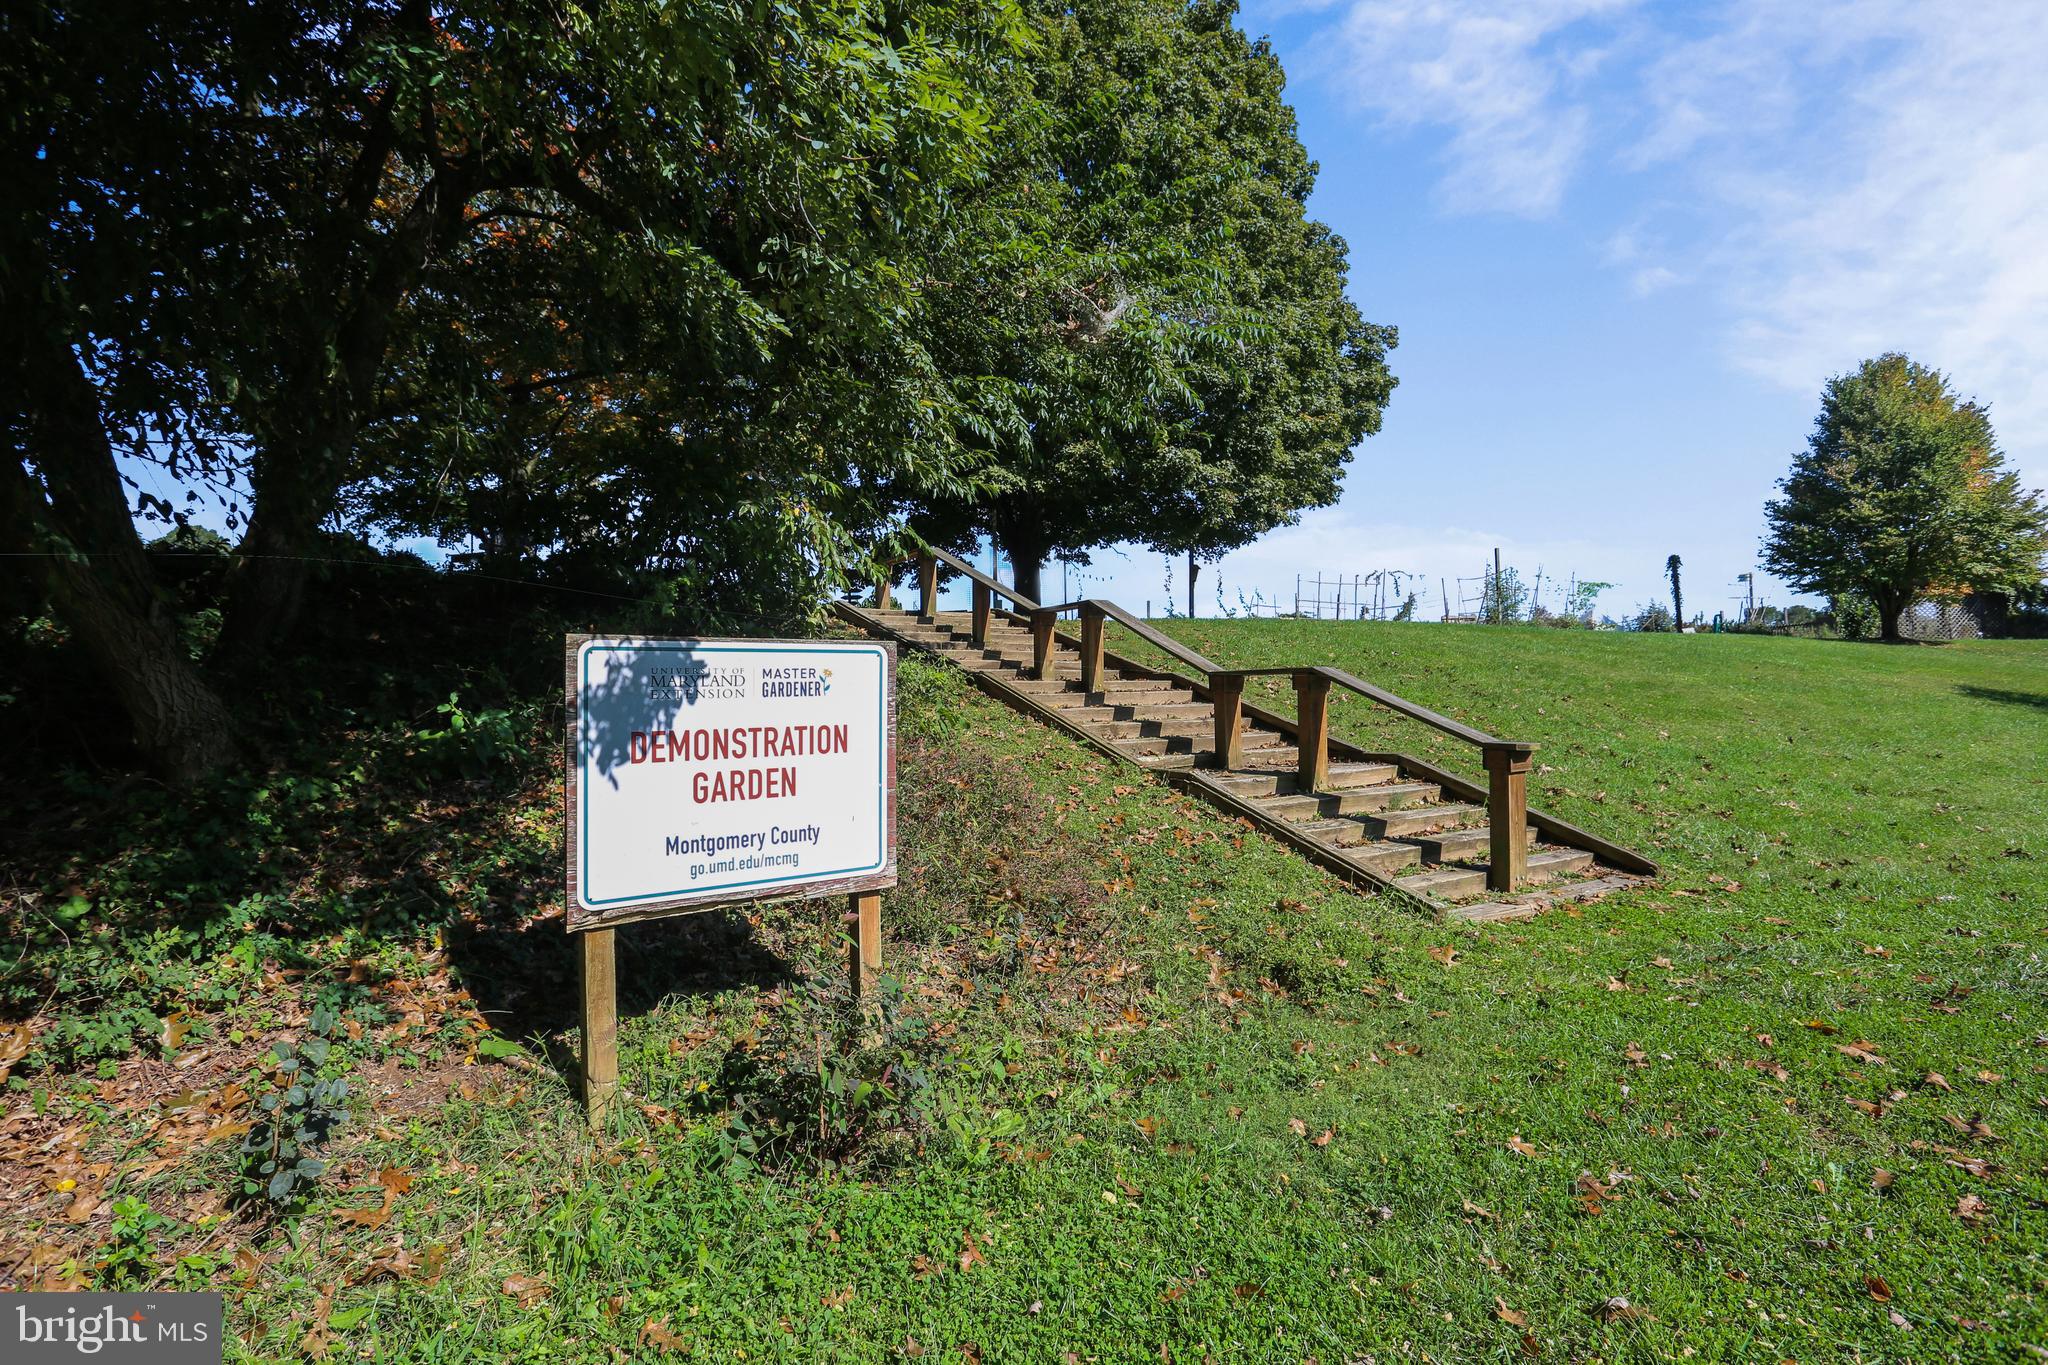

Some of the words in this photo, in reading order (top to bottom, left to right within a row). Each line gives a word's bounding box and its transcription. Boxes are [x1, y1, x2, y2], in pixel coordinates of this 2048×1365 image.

[651, 667, 728, 675] UNIVERSITY
[732, 667, 746, 675] OF
[762, 668, 816, 679] MASTER
[650, 675, 745, 688] MARYLAND
[762, 681, 821, 698] GARDENER
[651, 689, 745, 700] EXTENSION
[631, 724, 848, 764] DEMONSTRATION
[692, 767, 796, 803] GARDEN
[666, 832, 765, 856] Montgomery
[771, 824, 820, 845] County
[690, 853, 799, 879] go.umd.edu/mcmg
